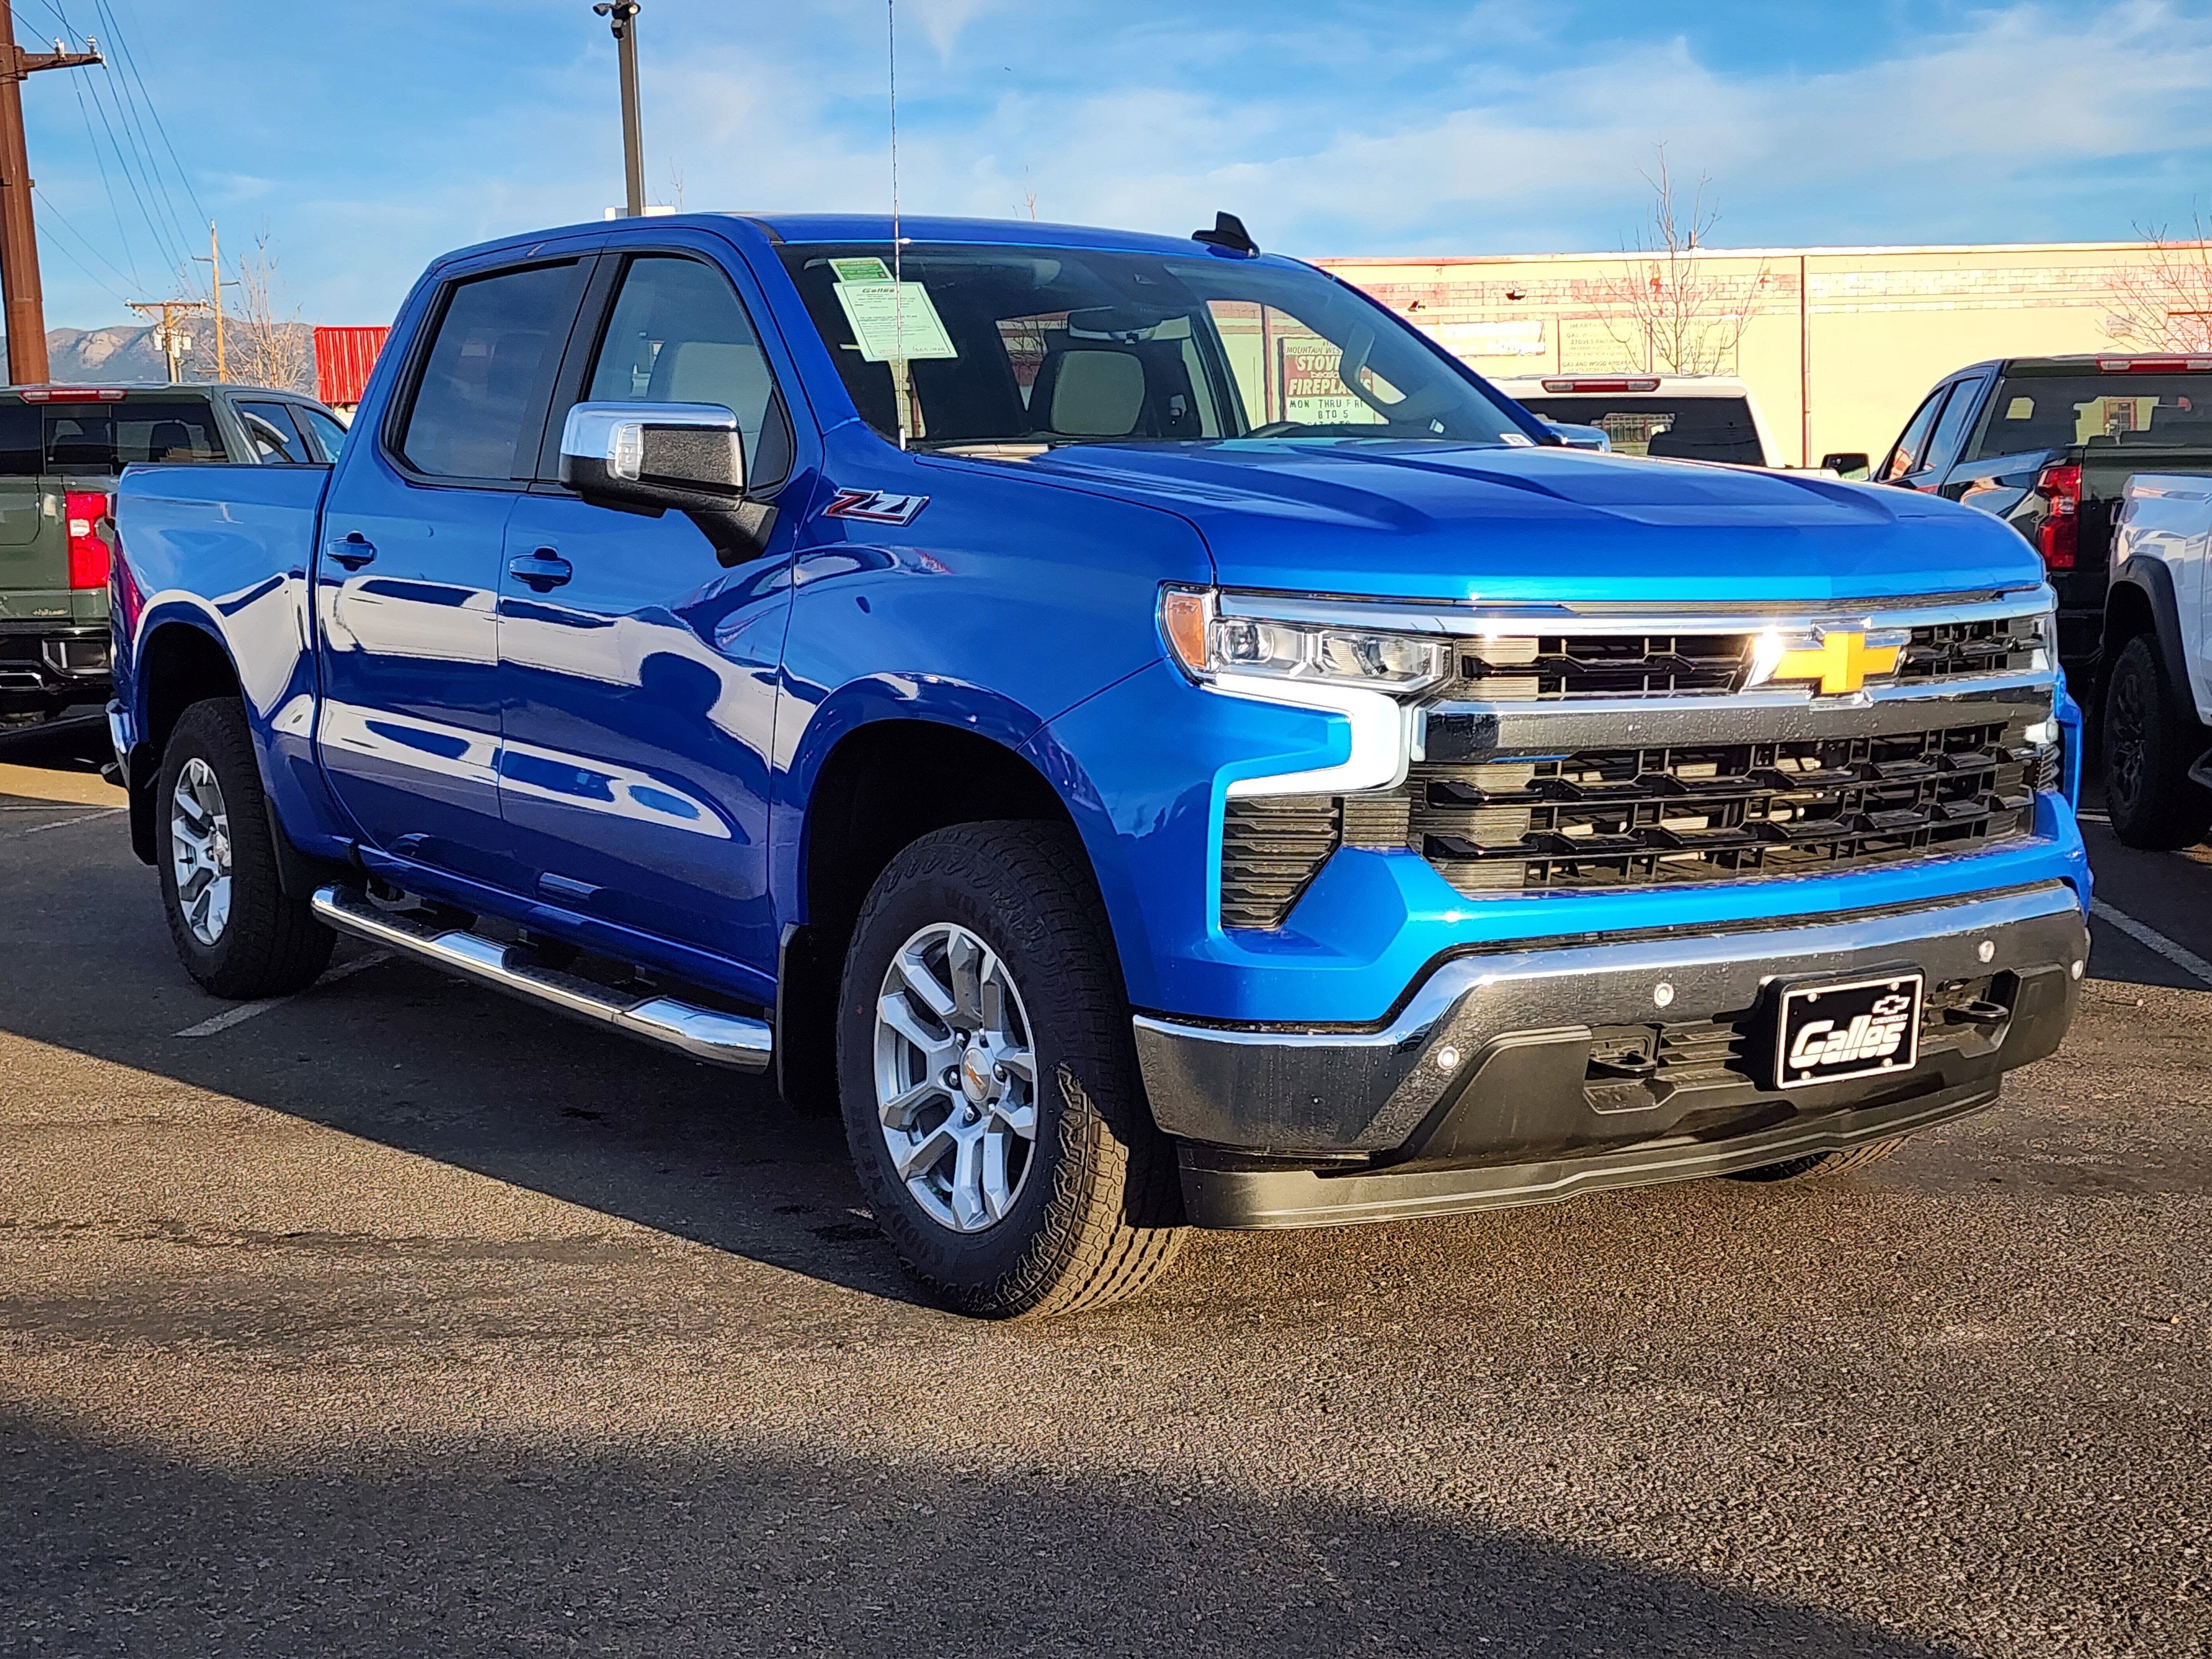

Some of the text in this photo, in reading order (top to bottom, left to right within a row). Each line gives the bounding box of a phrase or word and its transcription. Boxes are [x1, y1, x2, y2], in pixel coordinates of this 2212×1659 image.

[1296, 356, 1341, 372] STOV
[1289, 399, 1310, 408] MON
[1318, 399, 1342, 408] THRU
[1343, 410, 1348, 418] 5
[821, 487, 930, 525] Z71
[1789, 1015, 1907, 1068] Galles
